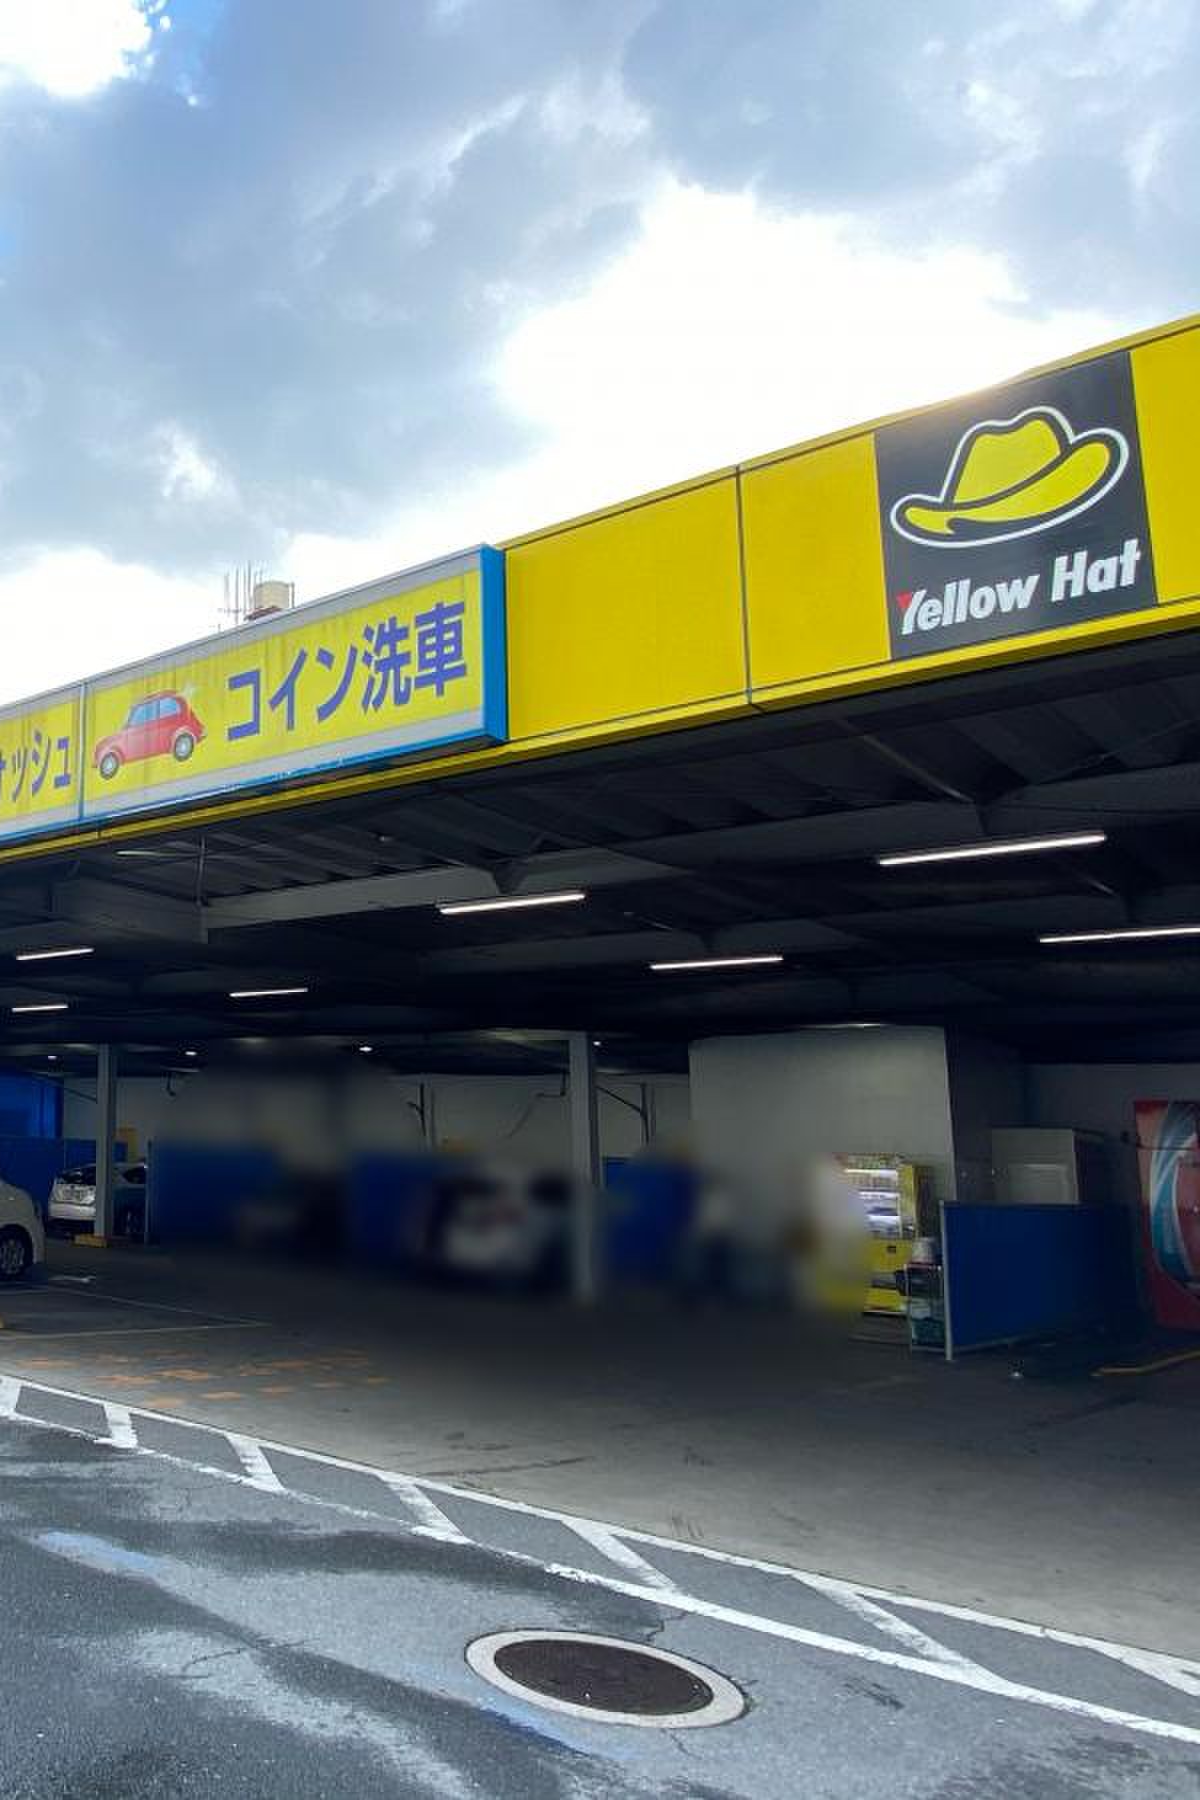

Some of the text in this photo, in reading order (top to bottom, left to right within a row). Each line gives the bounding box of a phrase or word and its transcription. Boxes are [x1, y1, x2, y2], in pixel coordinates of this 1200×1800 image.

[896, 538, 1141, 635] Yellow Hat
[226, 601, 468, 742] コイン洗車
